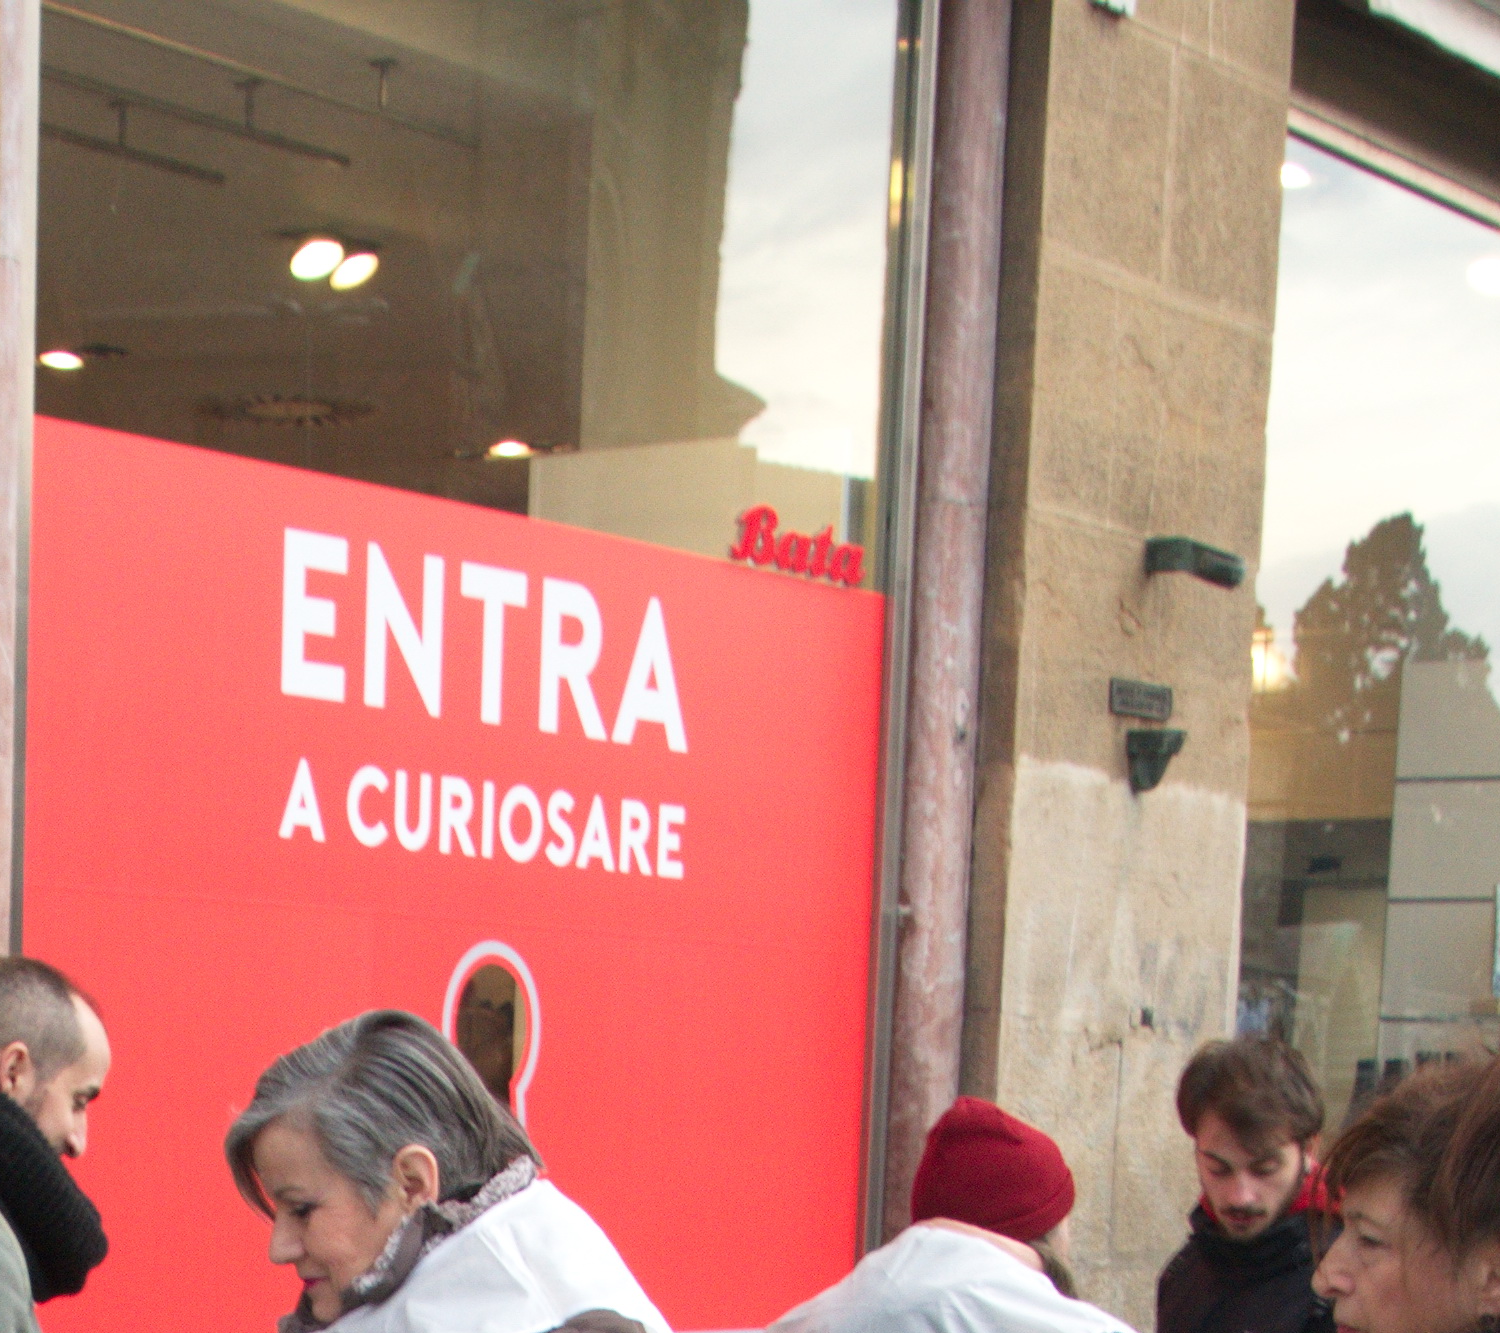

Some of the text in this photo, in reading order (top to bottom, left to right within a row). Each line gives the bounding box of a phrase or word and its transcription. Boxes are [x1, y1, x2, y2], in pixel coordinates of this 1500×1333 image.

[730, 504, 866, 589] Bata
[280, 527, 689, 753] ENTRA
[280, 758, 686, 879] A CURIOSARE
